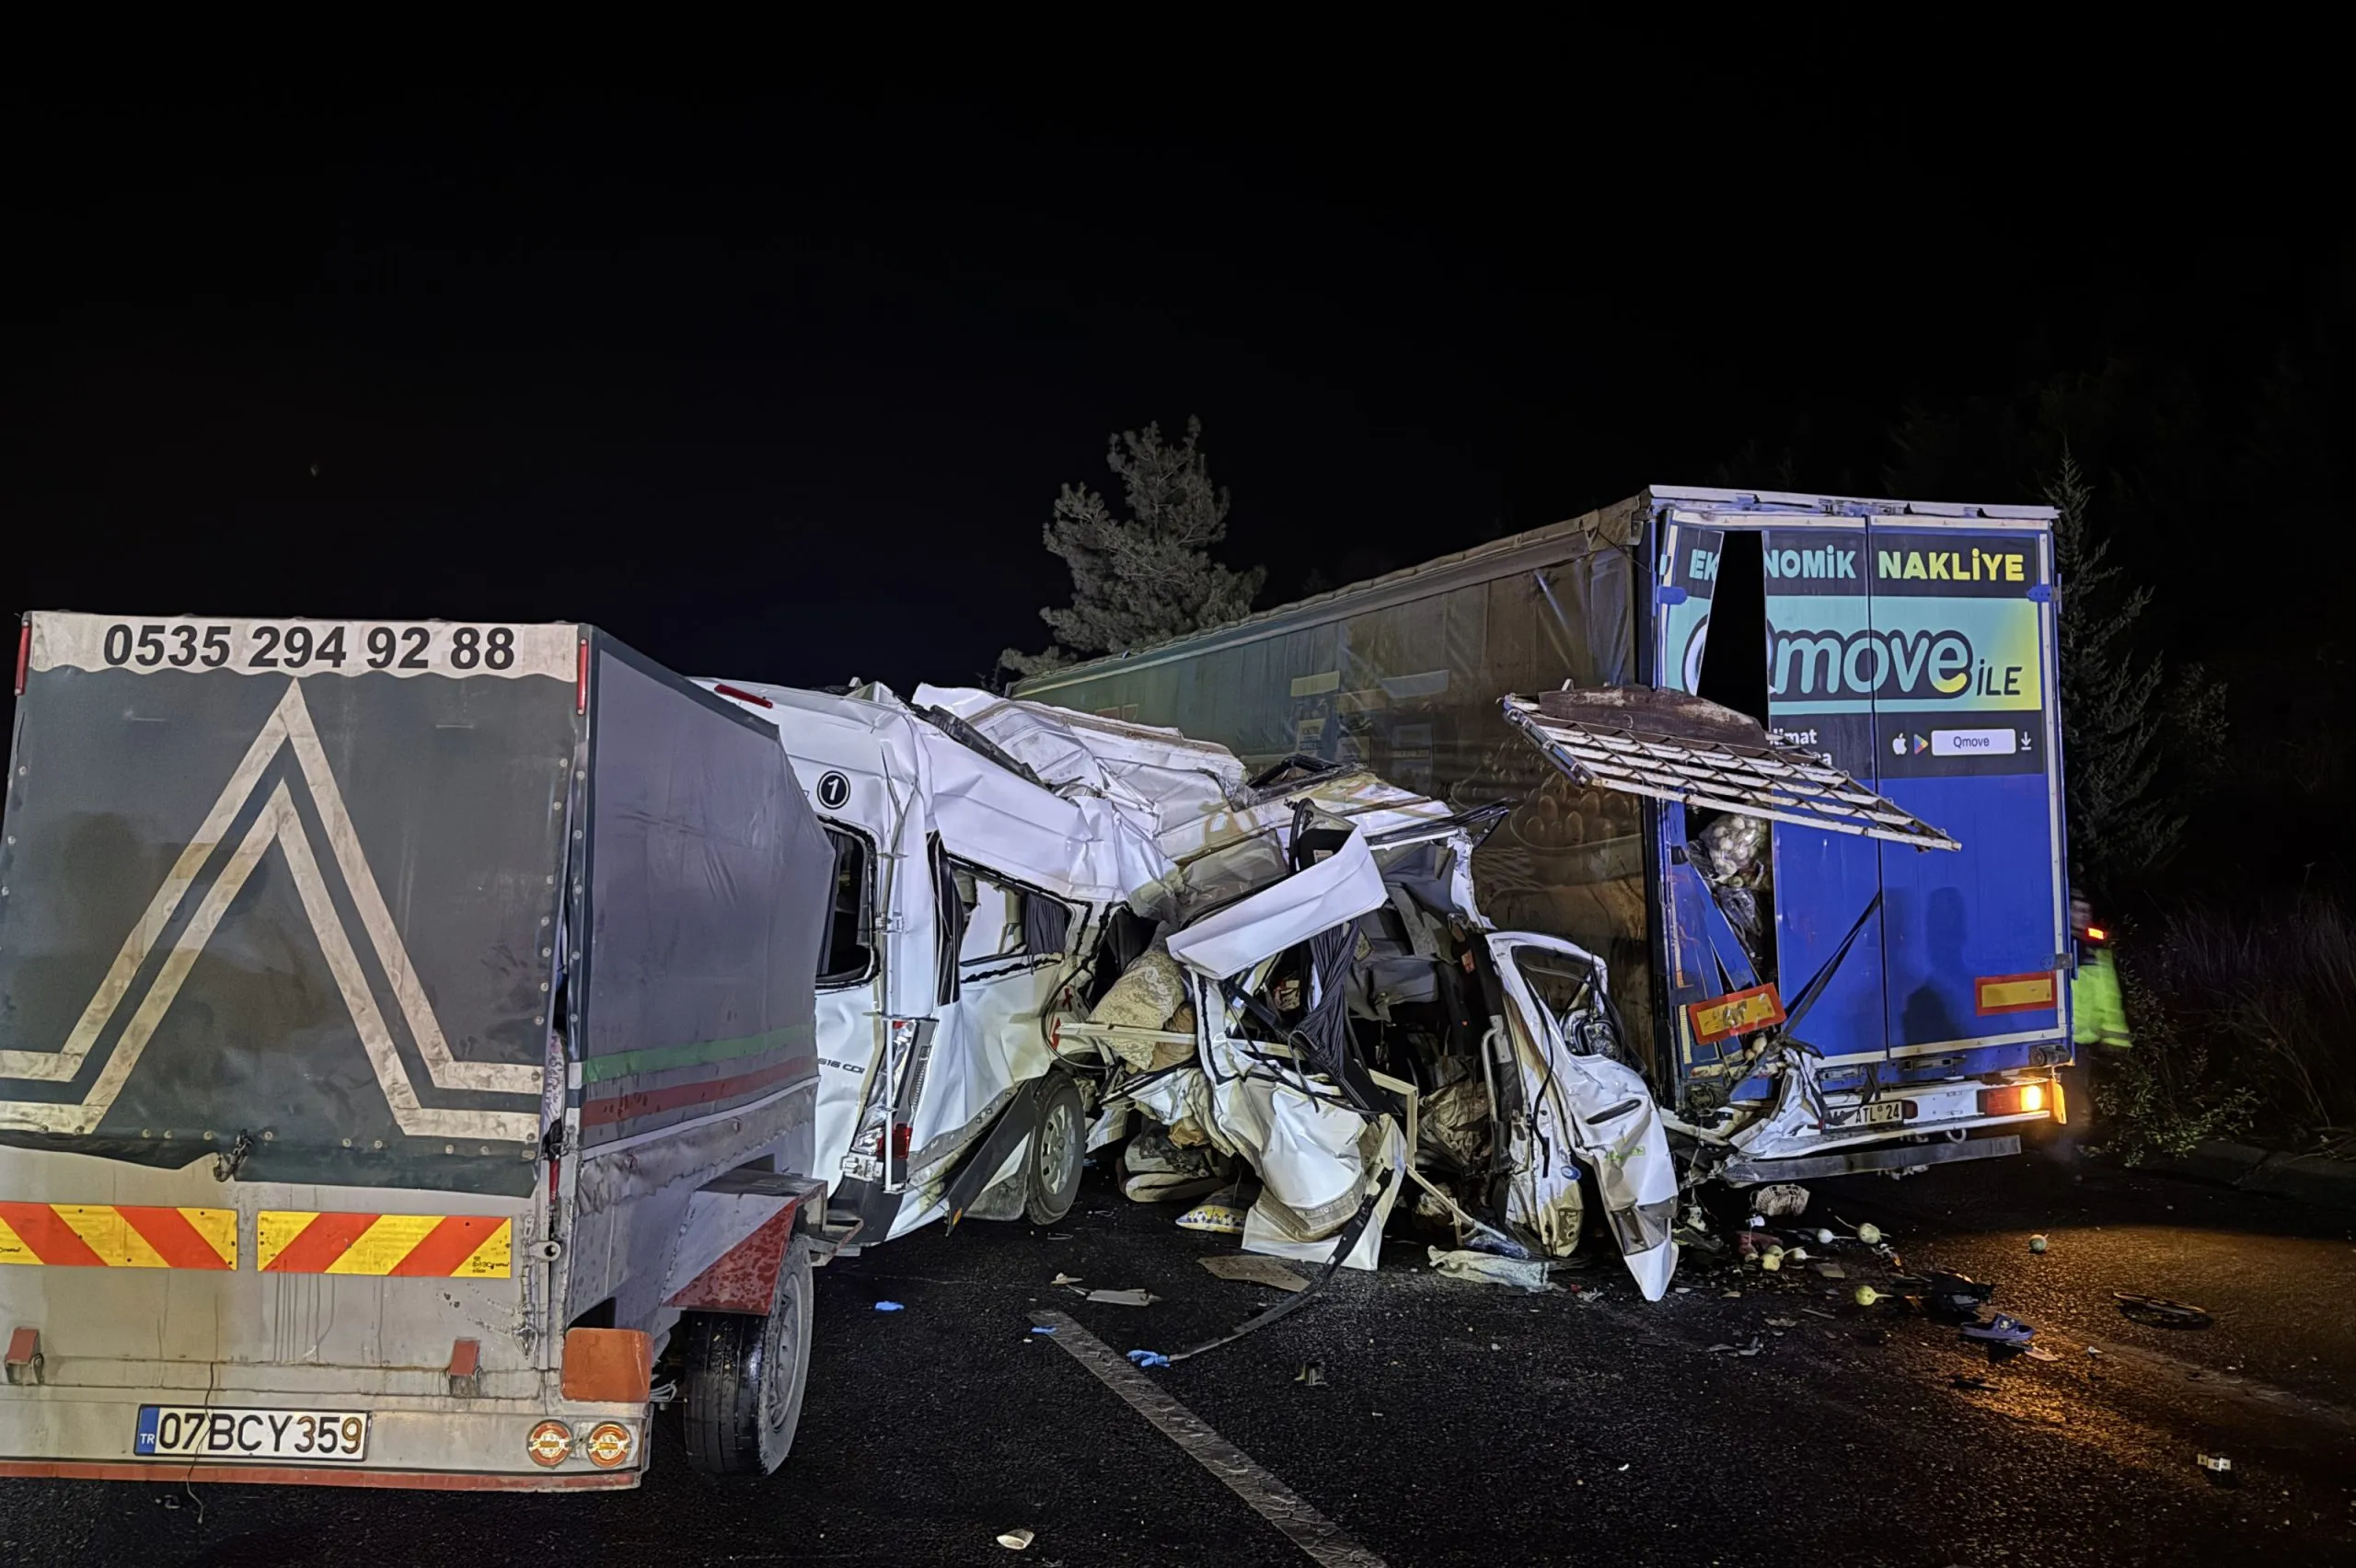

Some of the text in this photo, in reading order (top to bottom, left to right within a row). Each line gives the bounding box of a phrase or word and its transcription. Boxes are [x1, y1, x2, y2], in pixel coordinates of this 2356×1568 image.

[1689, 545, 2025, 582] EKNOMİK NAKLİYE
[103, 624, 515, 670] 0535 294 92 88
[1976, 658, 2023, 697] İLE
[1953, 735, 1990, 749] Qmove
[842, 1064, 865, 1075] CDI
[140, 1433, 155, 1445] TR
